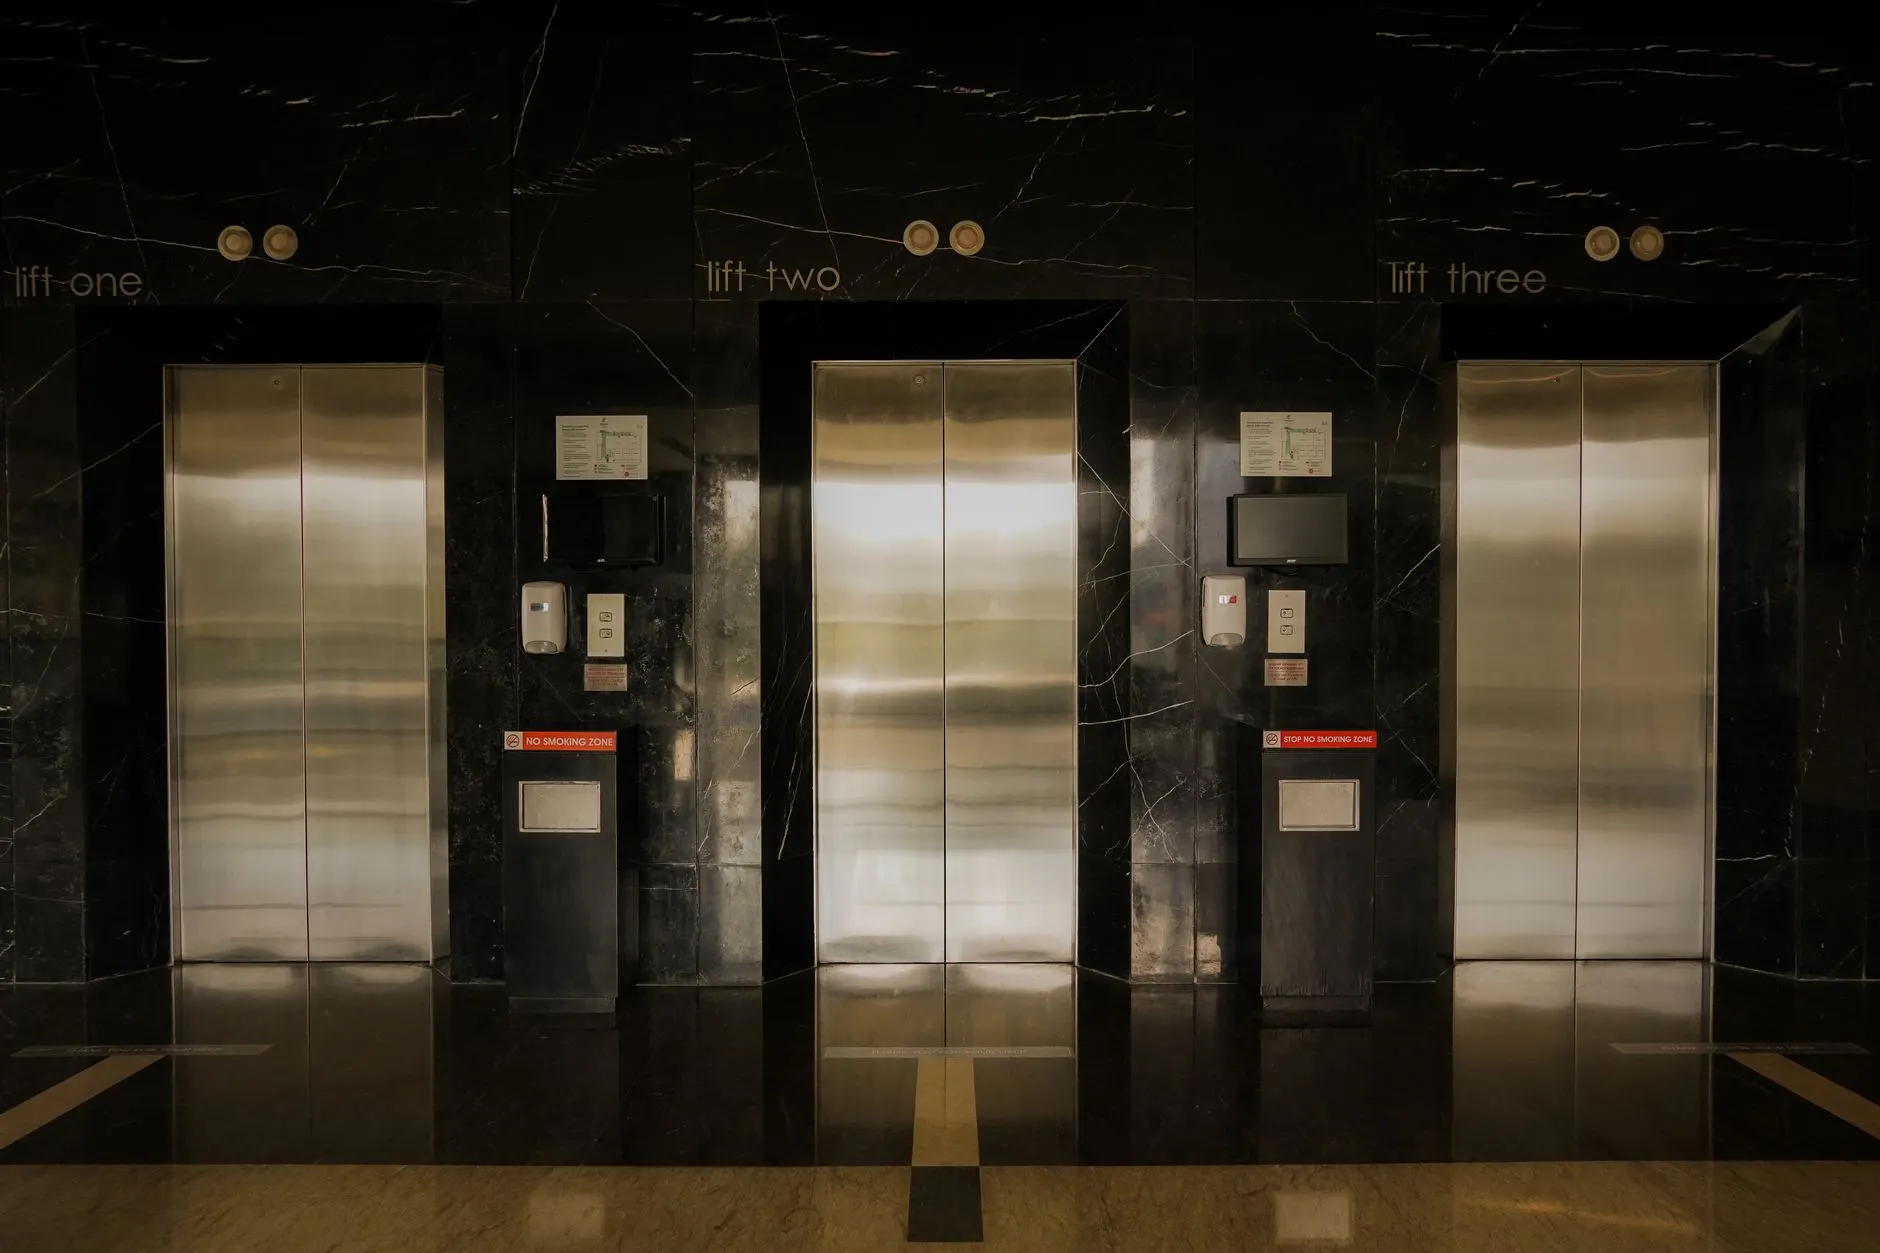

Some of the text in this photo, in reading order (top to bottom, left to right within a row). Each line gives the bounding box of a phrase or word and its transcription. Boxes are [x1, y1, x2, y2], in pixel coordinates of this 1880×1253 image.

[15, 266, 143, 297] lift one
[707, 260, 840, 292] lift two
[1391, 261, 1547, 294] lift three
[526, 737, 613, 746] NO SMOKING ZONE
[1284, 735, 1301, 743] STOP
[1303, 735, 1316, 743] NO
[1317, 735, 1352, 743] SMOKING
